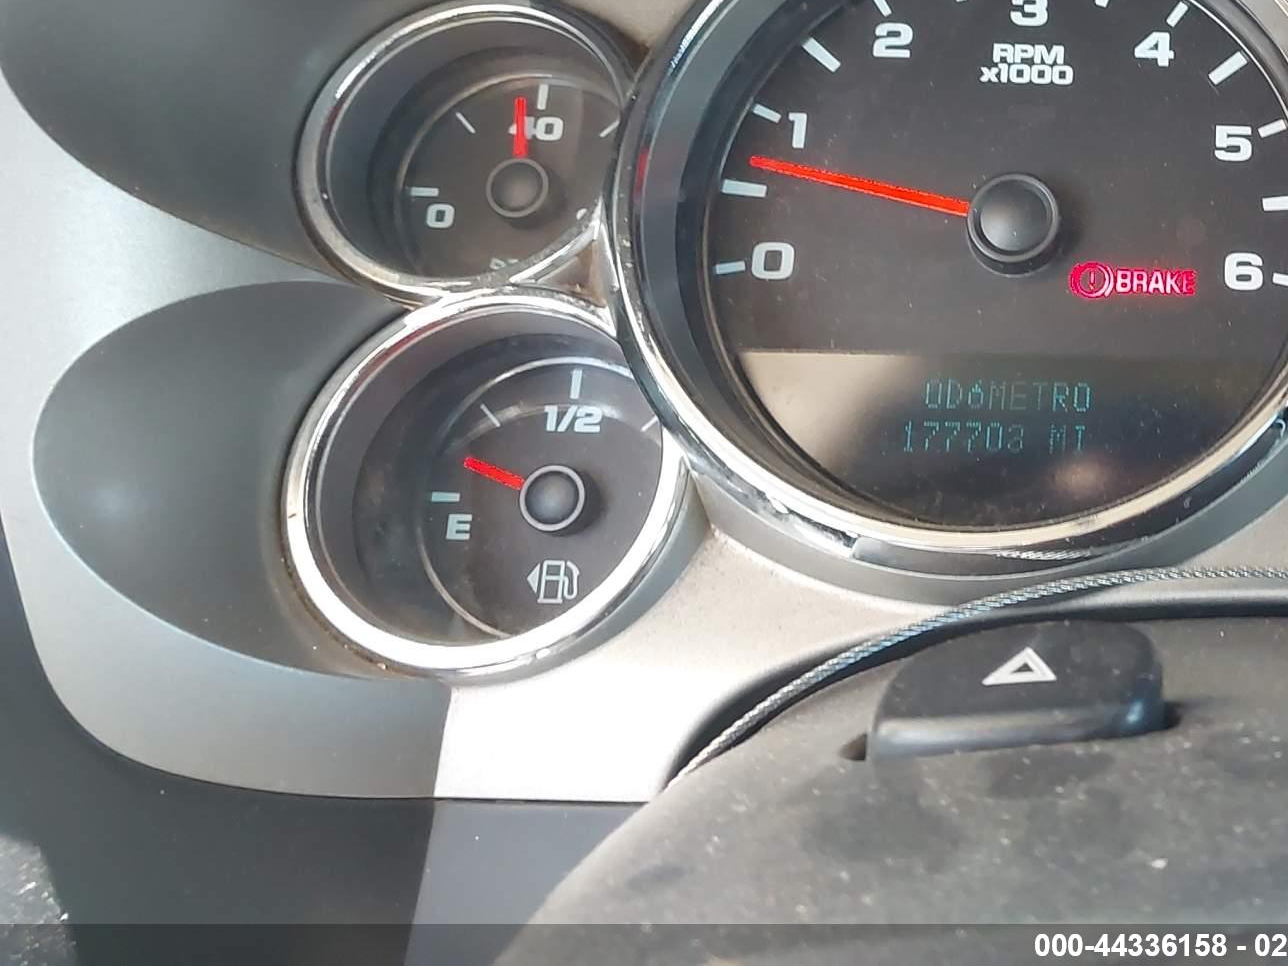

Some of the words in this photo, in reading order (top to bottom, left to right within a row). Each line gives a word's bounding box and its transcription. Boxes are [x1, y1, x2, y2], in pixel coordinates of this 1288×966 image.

[873, 23, 913, 59] 2
[993, 44, 1065, 64] RPM
[1134, 32, 1174, 68] 4
[980, 65, 1074, 86] x1000
[788, 113, 808, 149] 1
[1214, 125, 1252, 163] 5
[426, 203, 455, 229] 0
[751, 242, 795, 281] 0
[1224, 253, 1264, 292] 6
[1115, 269, 1196, 296] BRAKE
[544, 406, 602, 432] 1/2
[446, 513, 473, 541] E
